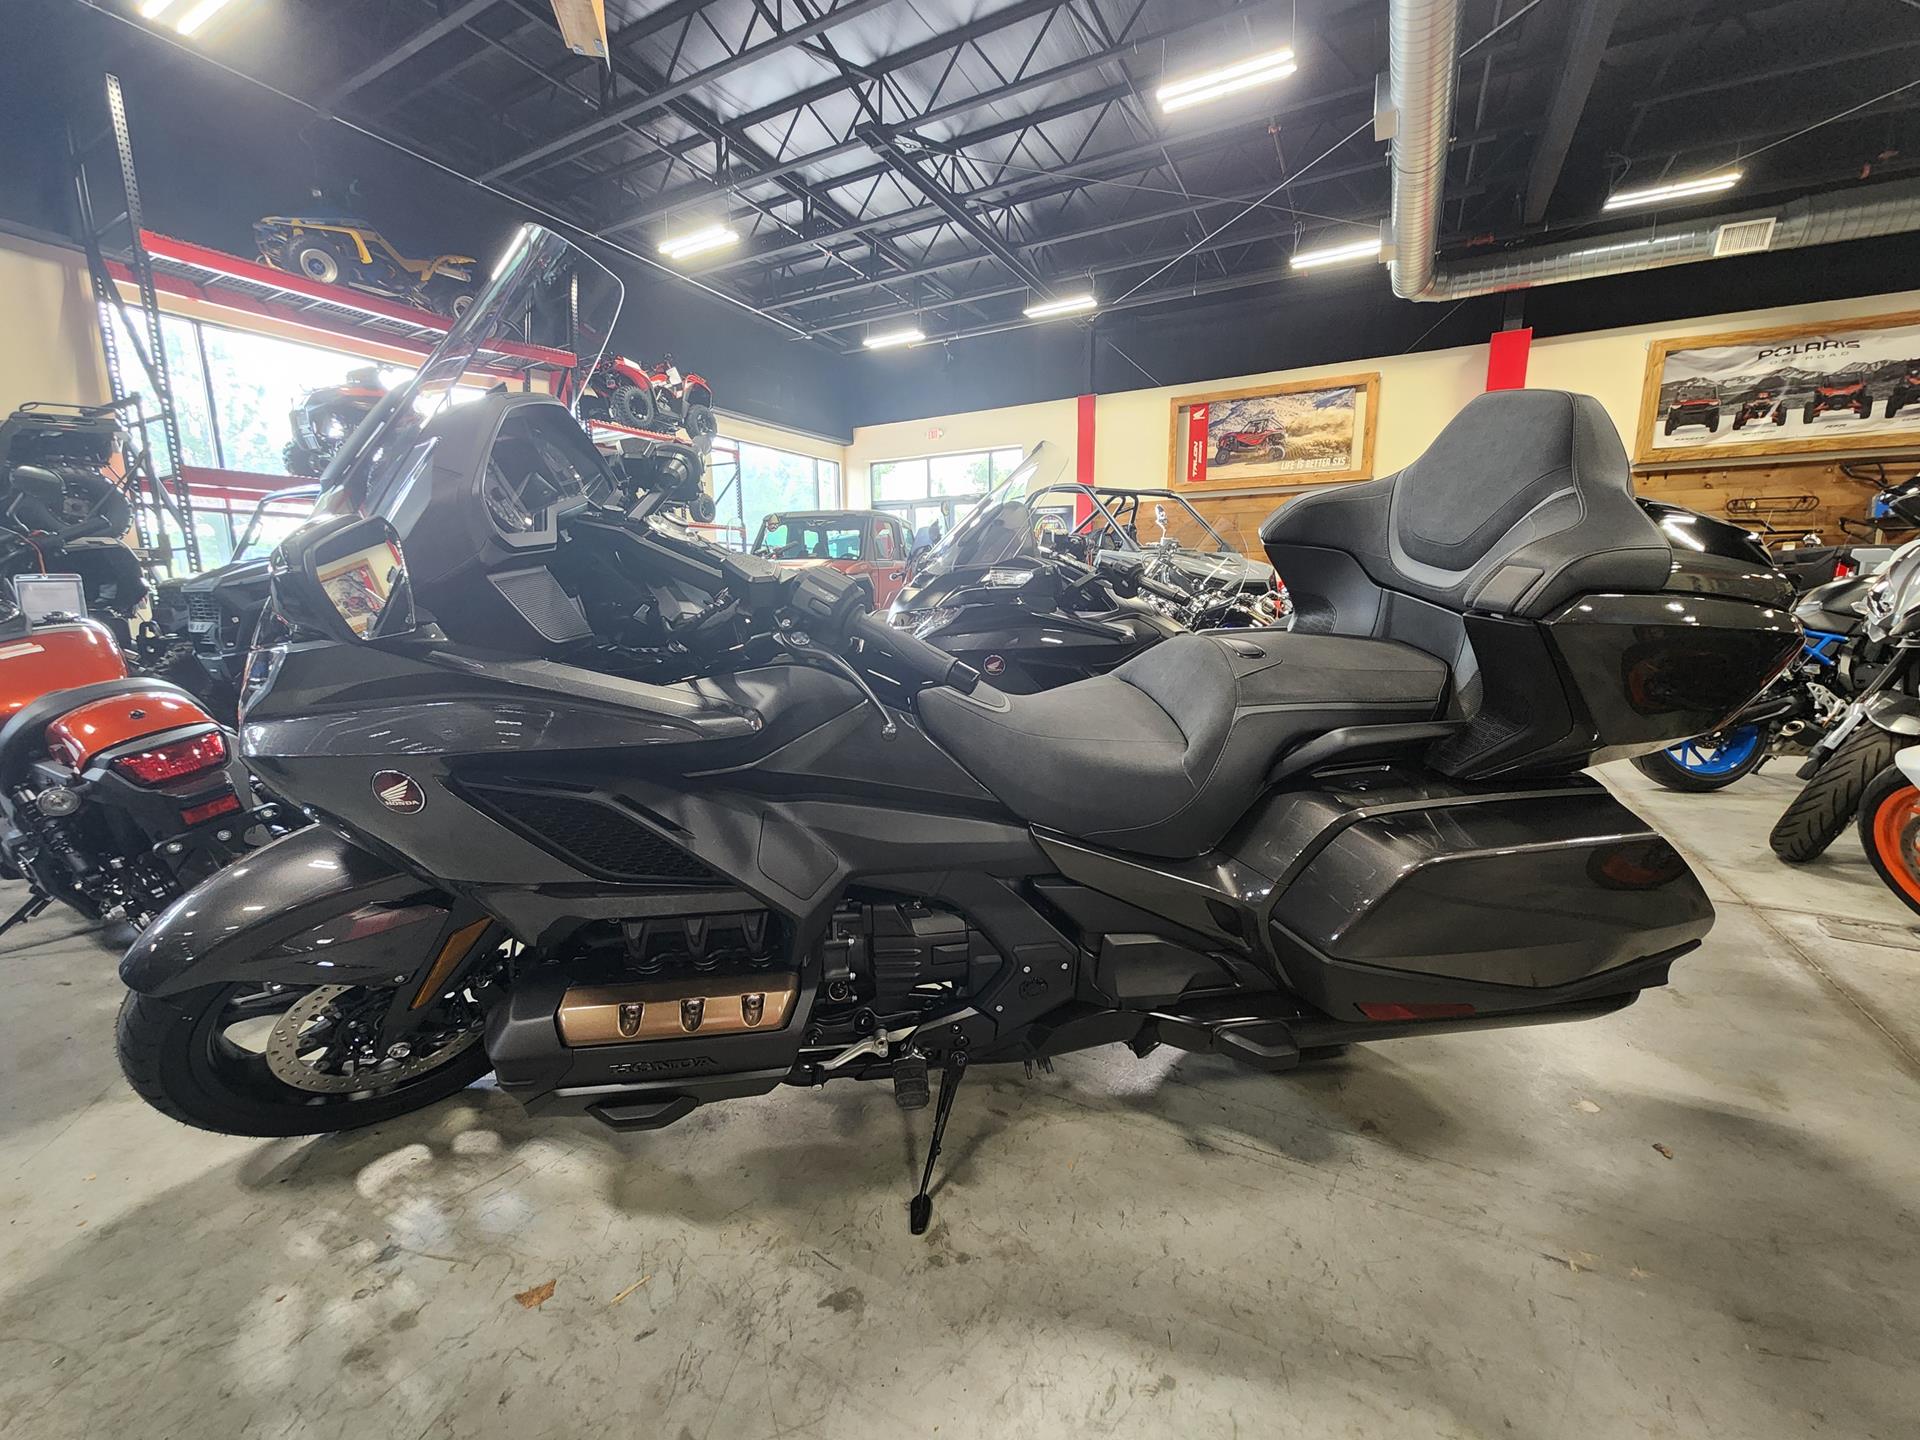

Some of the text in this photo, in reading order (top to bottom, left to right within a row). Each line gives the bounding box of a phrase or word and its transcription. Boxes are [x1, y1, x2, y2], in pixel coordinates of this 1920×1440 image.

[1757, 339, 1861, 361] POLARIS
[1280, 459, 1295, 471] LIFE
[1296, 458, 1304, 470] IS
[1304, 457, 1331, 469] BETTER
[607, 1055, 719, 1074] HONDA
